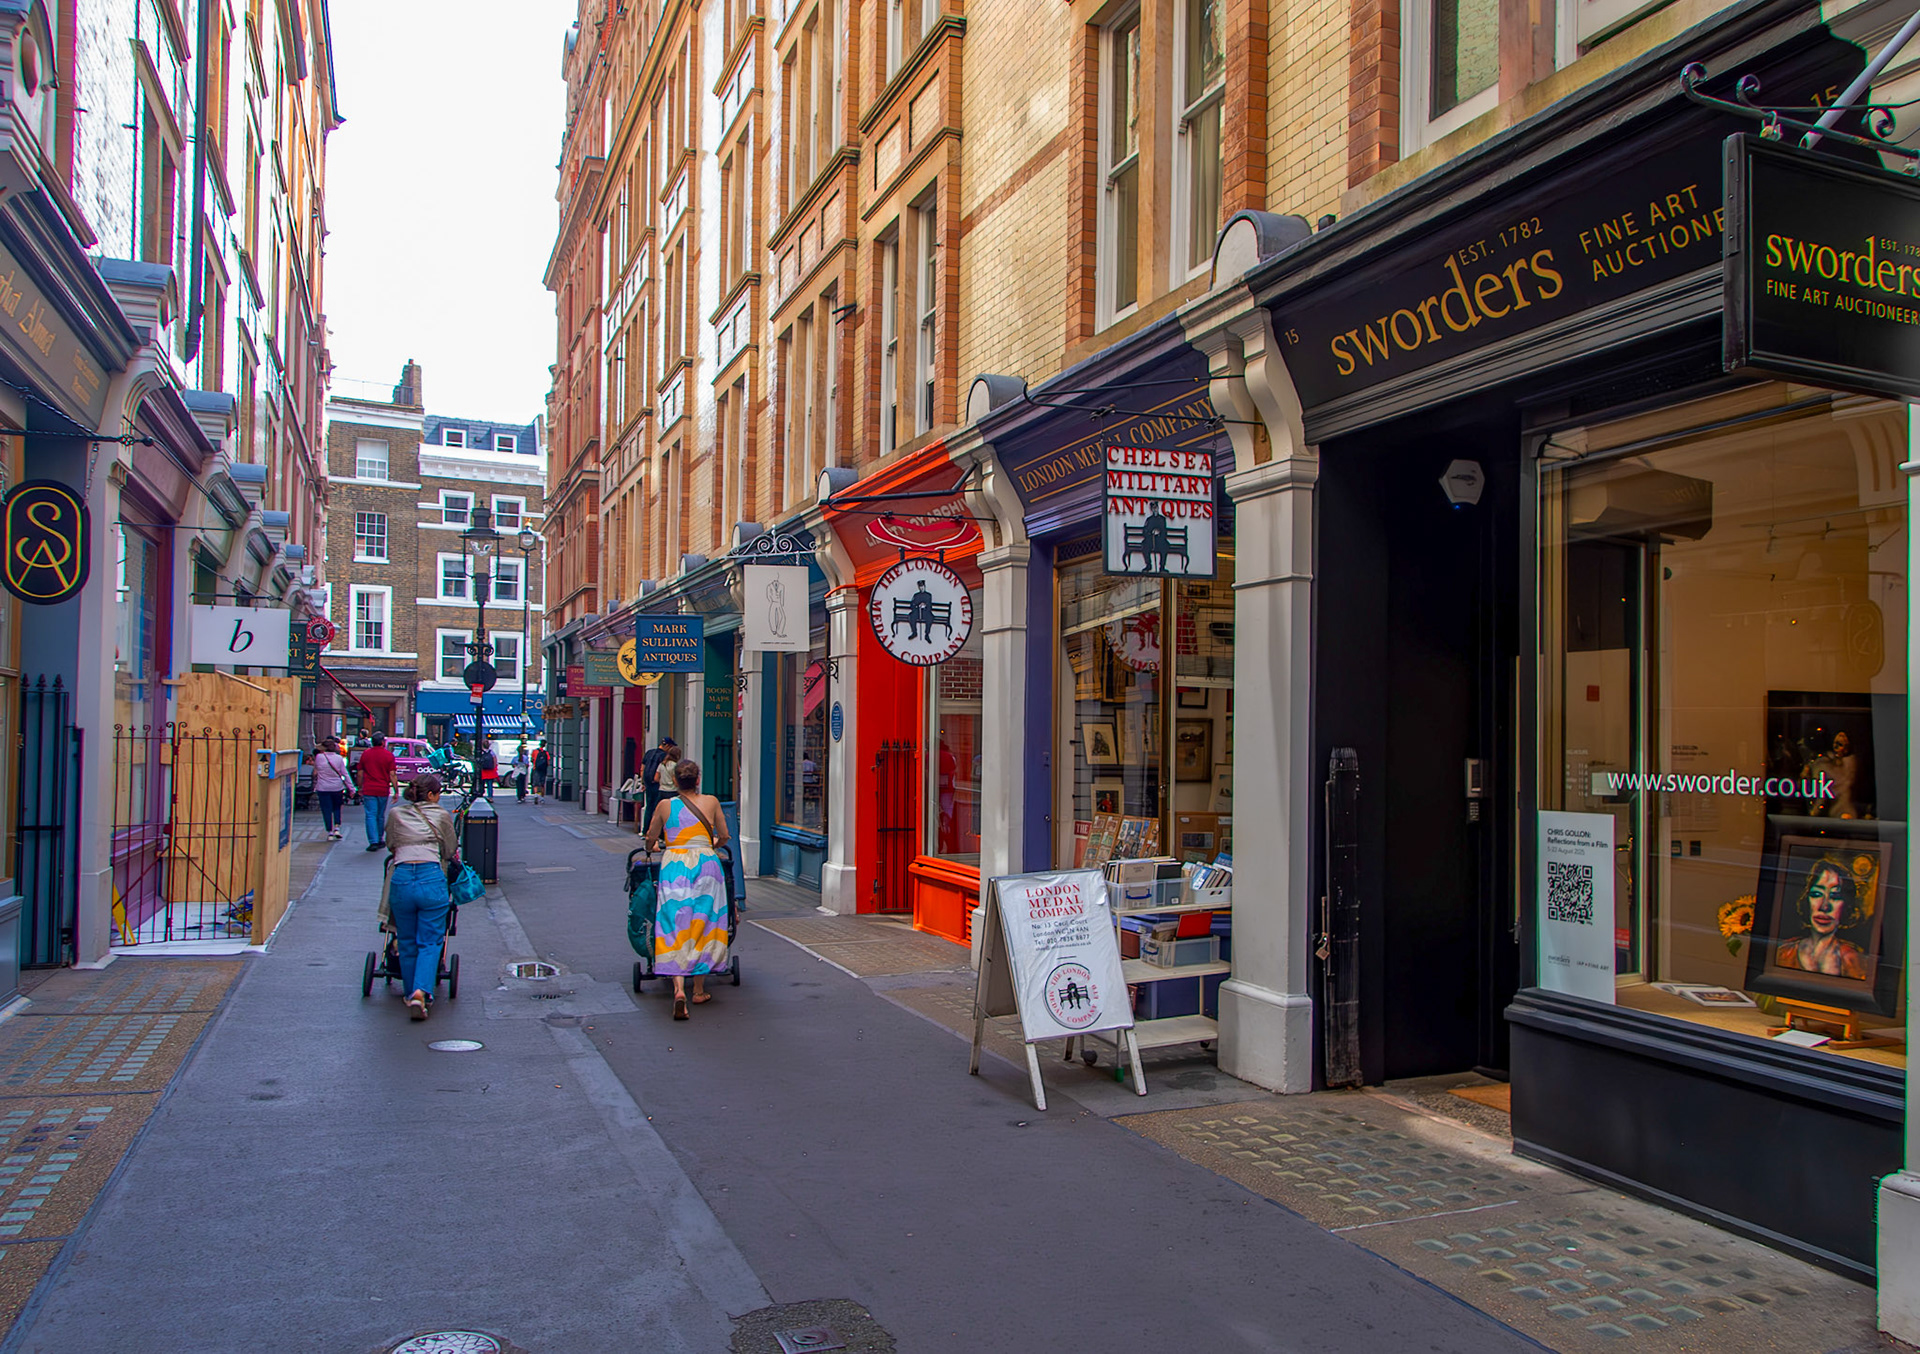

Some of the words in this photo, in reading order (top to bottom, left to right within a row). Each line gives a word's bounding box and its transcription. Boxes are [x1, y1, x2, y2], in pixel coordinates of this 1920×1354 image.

[1579, 212, 1639, 254] FINE
[1650, 184, 1698, 226] ART
[1459, 240, 1495, 266] EST.
[1499, 217, 1544, 248] 1782
[1881, 238, 1900, 252] EST.
[1767, 279, 1797, 300] FINE
[1802, 287, 1829, 306] ART
[1834, 294, 1920, 326] AUCTIONEER
[1331, 249, 1563, 375] sworders
[1284, 329, 1300, 346] 15
[1018, 456, 1077, 493] LONDON
[1129, 396, 1215, 445] COMPANY
[1107, 445, 1211, 471] CHELSEA
[1107, 471, 1212, 495] MILITARY
[1108, 497, 1213, 520] ANTQUES
[878, 566, 903, 590] THE
[904, 559, 960, 588] LONDON
[228, 618, 254, 653] b
[653, 624, 687, 634] MARK
[871, 600, 894, 654] MEDAL
[900, 633, 965, 665] COMPANY
[960, 595, 972, 625] LTD
[642, 638, 698, 647] SULLIVAN
[643, 653, 697, 664] ANTIQUES
[264, 763, 269, 773] 8
[1607, 769, 1834, 799] www.sworder.co.uk
[1077, 824, 1089, 834] THE
[1547, 837, 1576, 846] Reflections
[1577, 839, 1590, 847] from
[1025, 883, 1080, 898] LONDON
[1029, 895, 1083, 909] MEDAL
[1030, 904, 1084, 919] COMPANY
[1033, 930, 1054, 938] London
[1062, 968, 1090, 981] LONDON
